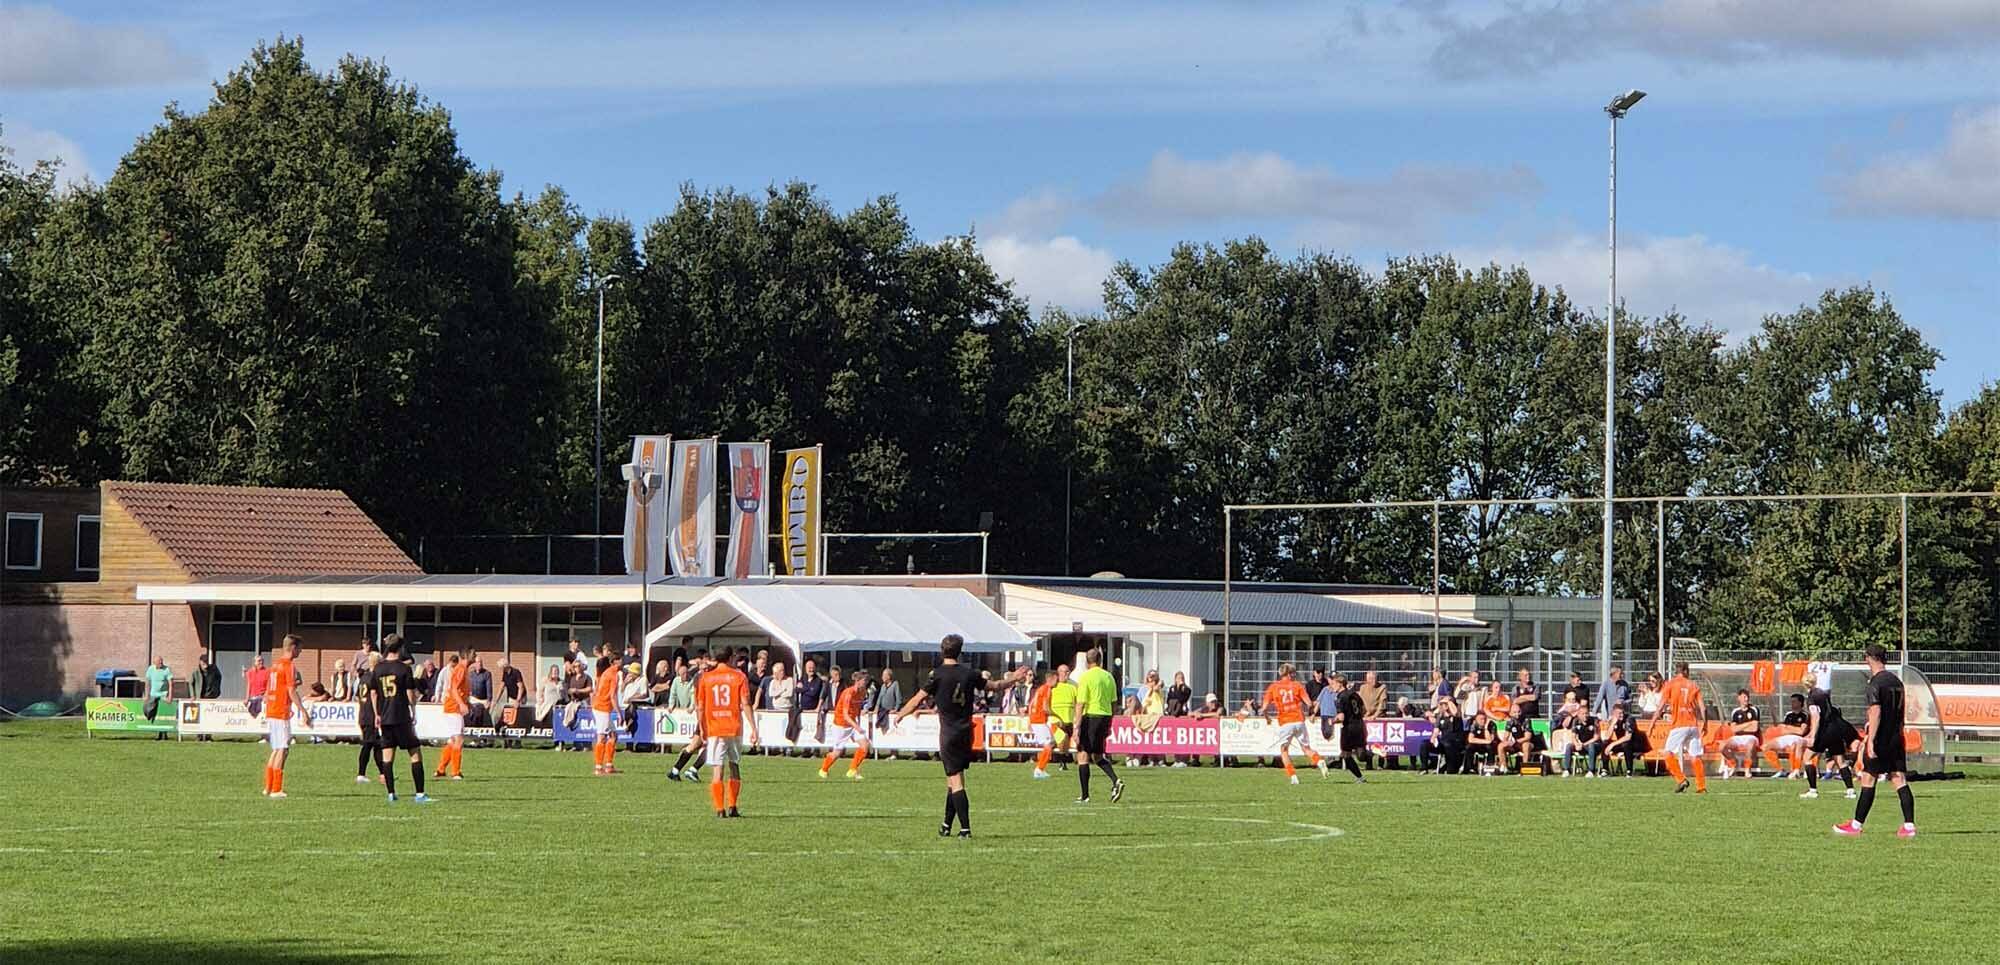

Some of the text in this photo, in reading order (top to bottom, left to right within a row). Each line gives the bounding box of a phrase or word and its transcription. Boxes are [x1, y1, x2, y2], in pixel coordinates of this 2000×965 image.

[379, 674, 397, 698] 15
[951, 682, 966, 707] 4
[1279, 685, 1294, 704] 21
[712, 684, 731, 707] 13
[1680, 687, 1689, 705] 7
[1351, 699, 1360, 715] 8
[88, 711, 135, 722] KRAMER'S
[527, 726, 553, 737] Joure
[1109, 727, 1218, 745] AMSTEL BIER
